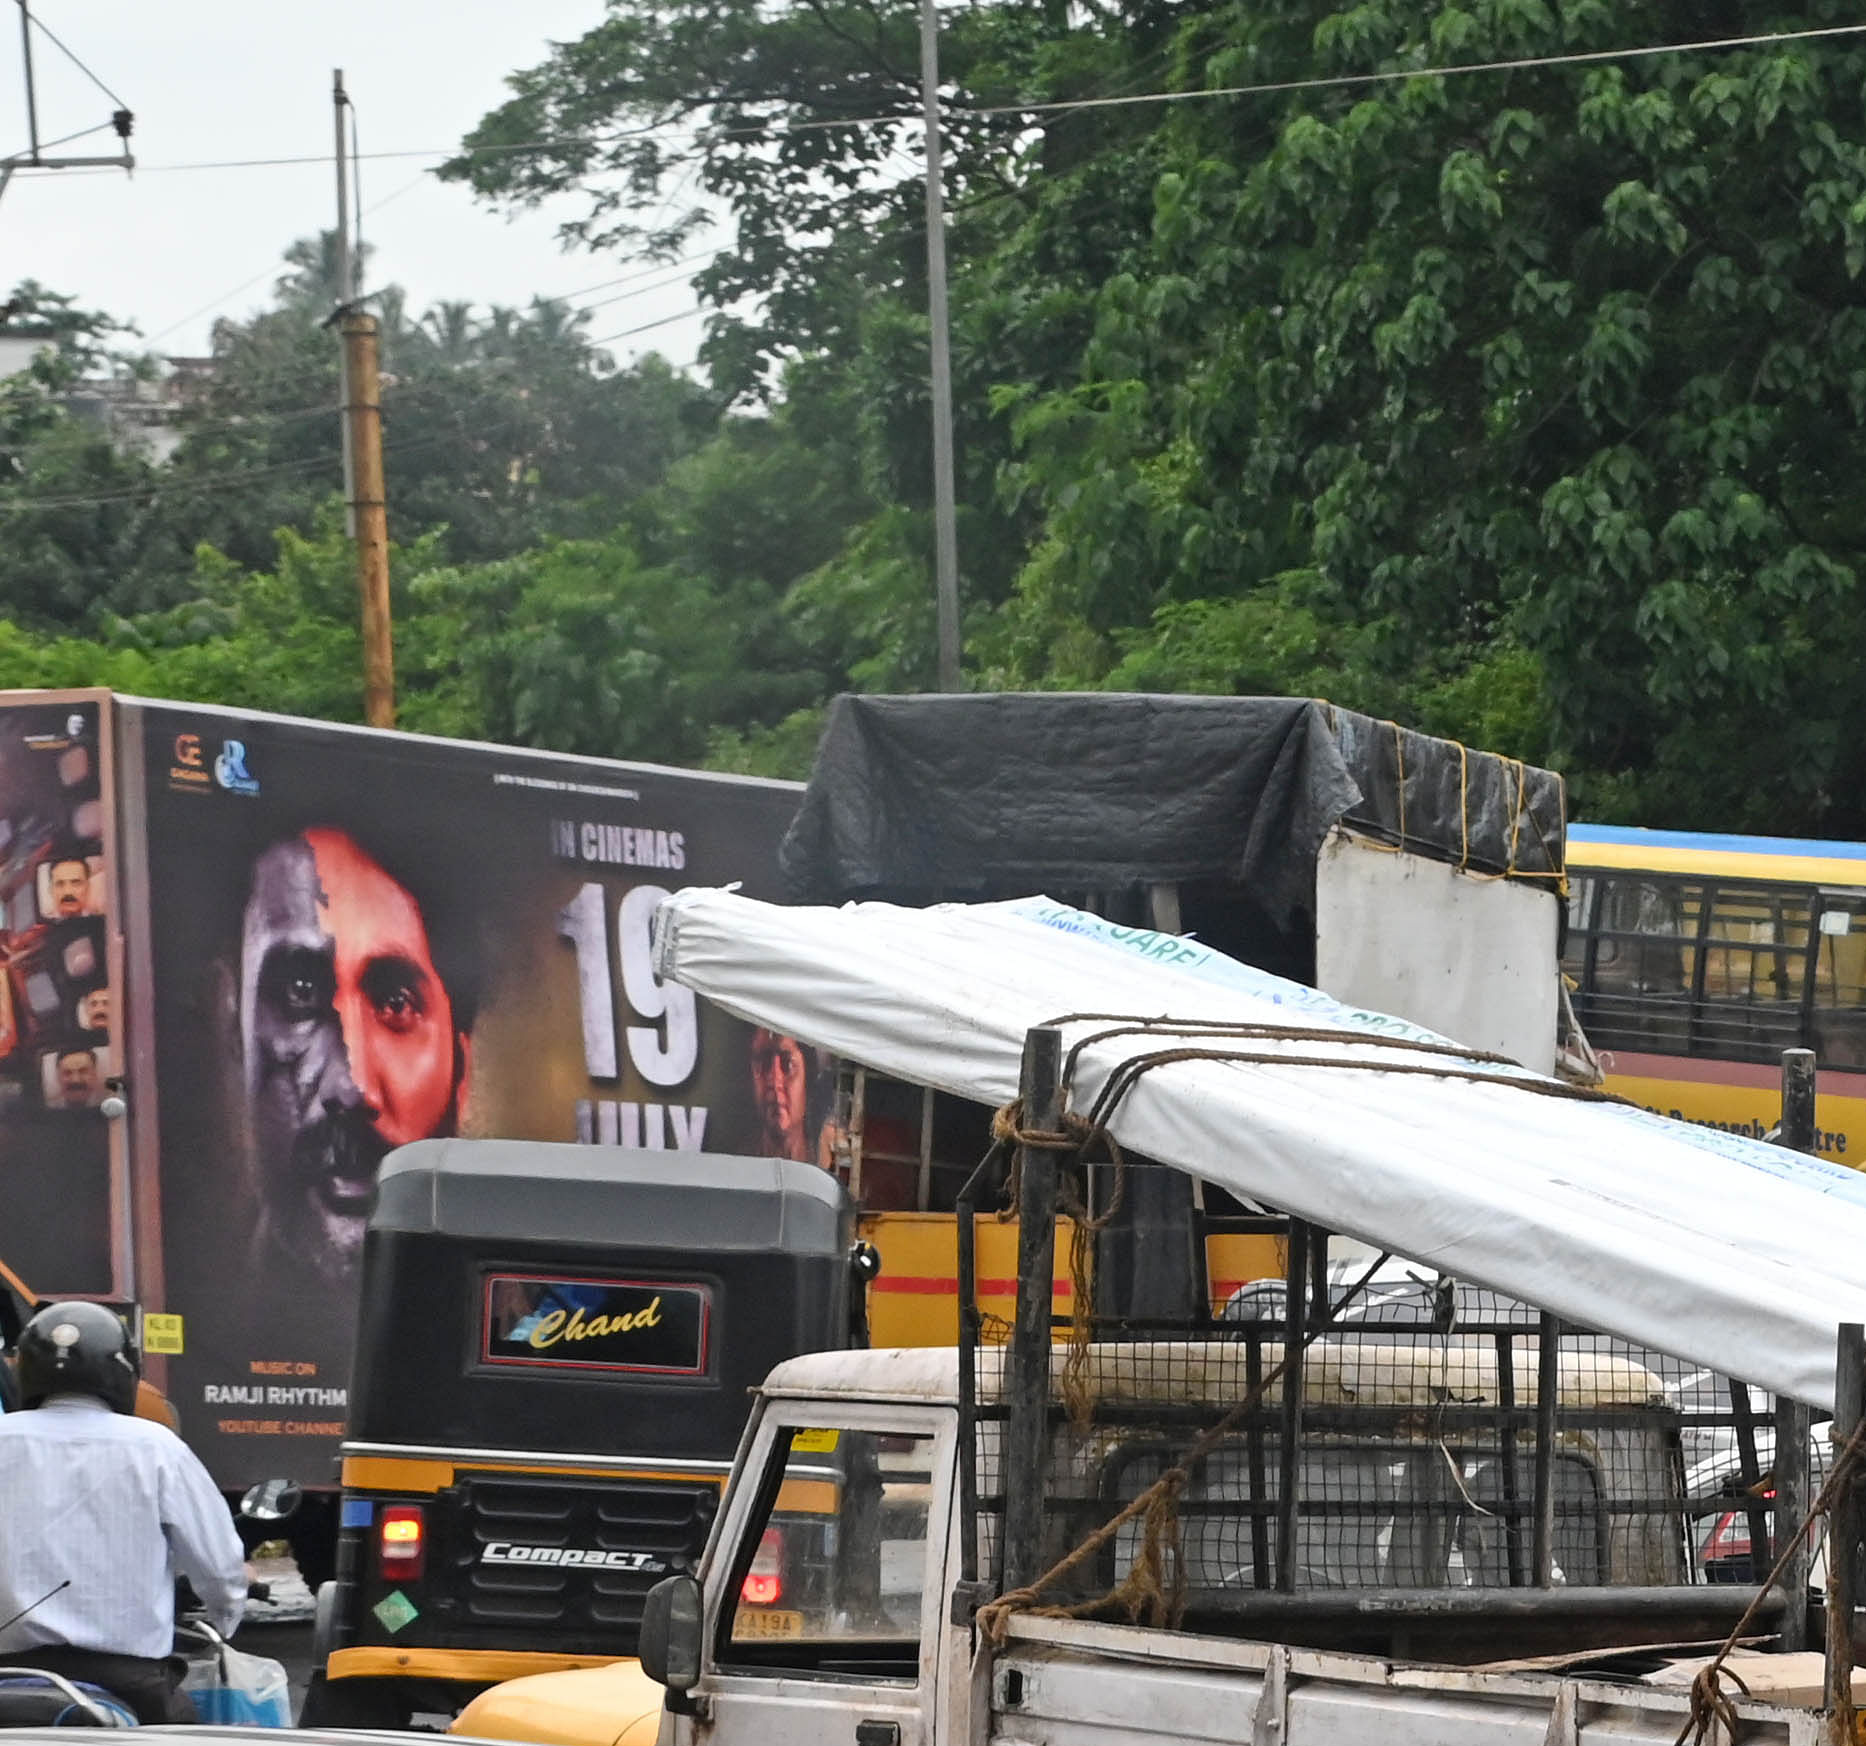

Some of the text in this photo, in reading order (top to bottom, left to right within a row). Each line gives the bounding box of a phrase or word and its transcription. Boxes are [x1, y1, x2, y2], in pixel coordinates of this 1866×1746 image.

[581, 823, 686, 870] CINEMAS
[558, 883, 699, 1086] 19
[531, 1296, 661, 1348] Chand
[295, 1362, 317, 1376] ON
[204, 1384, 348, 1408] RAMJI RHYTHM
[218, 1419, 282, 1435] YOUTUBE
